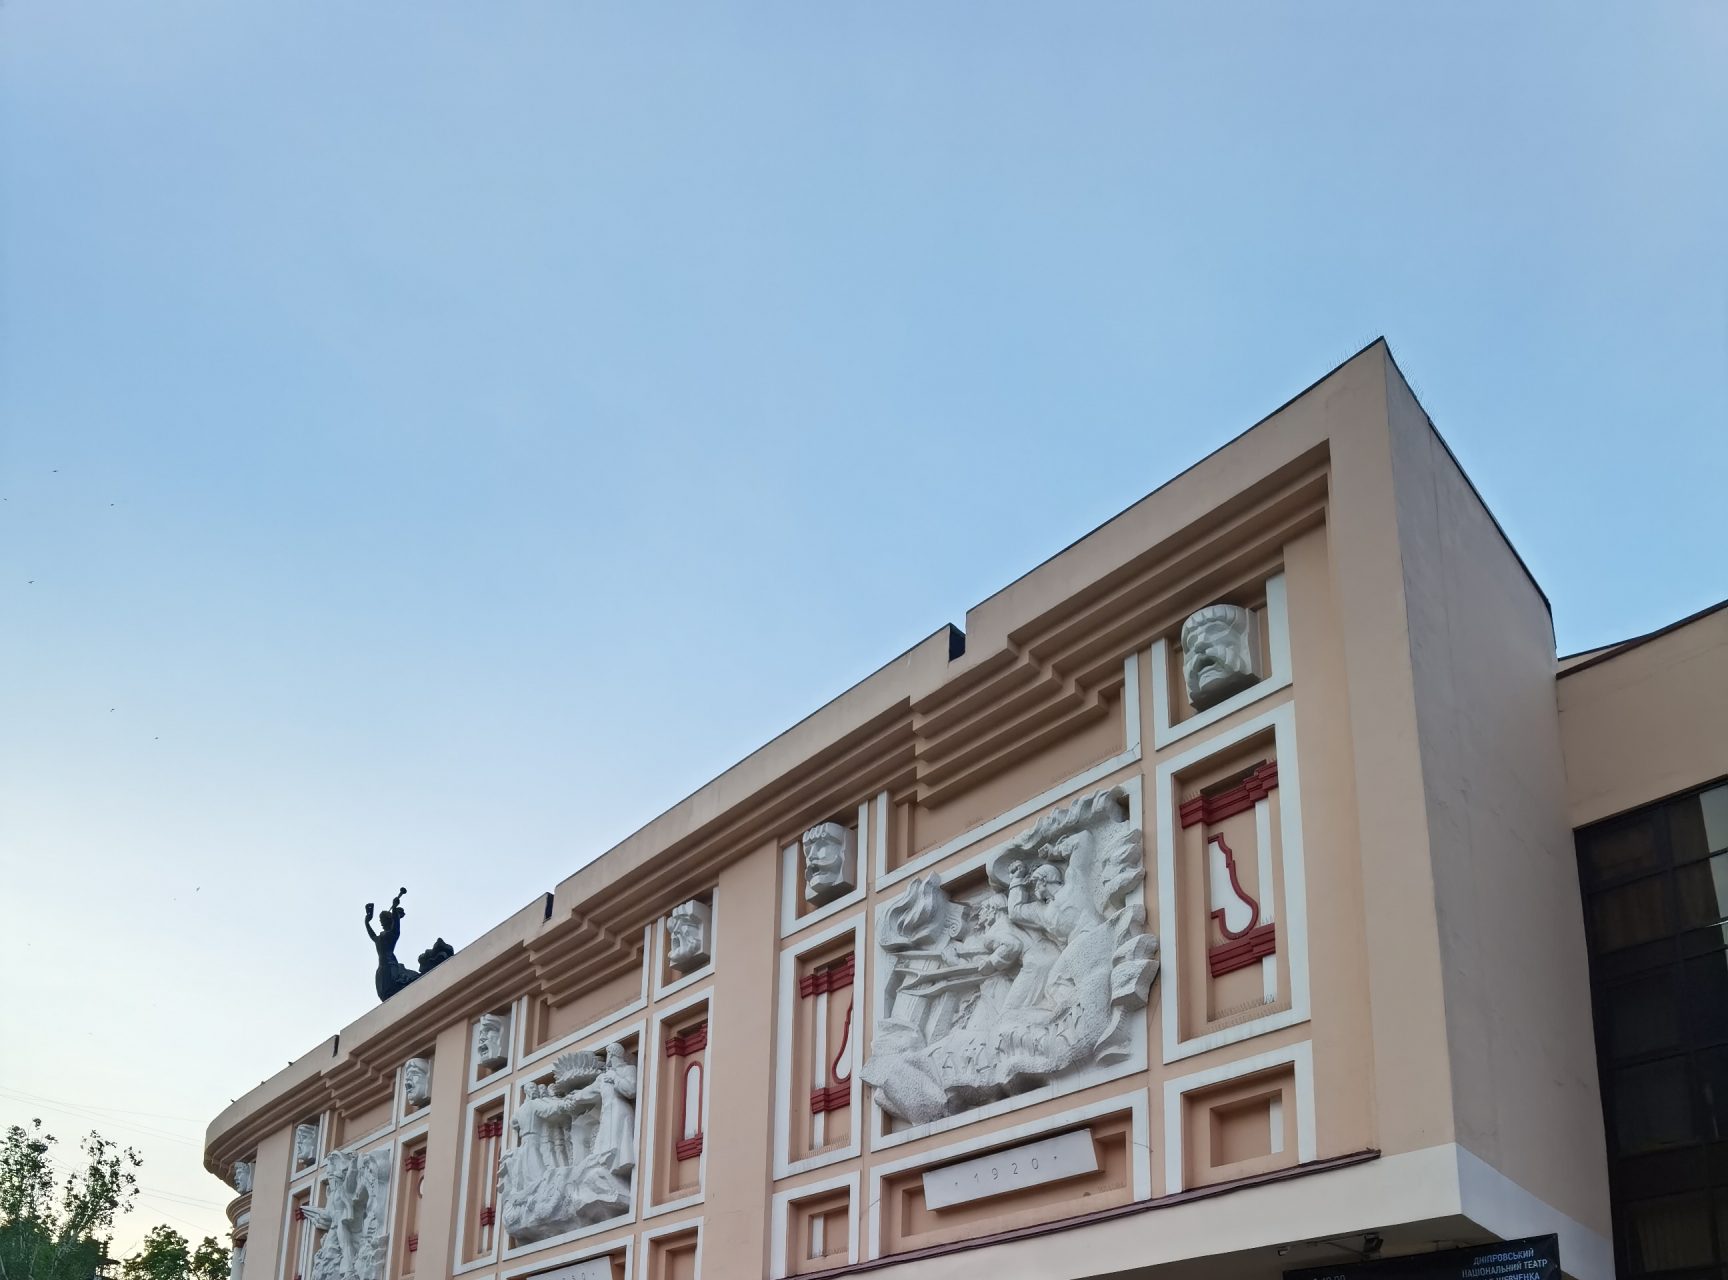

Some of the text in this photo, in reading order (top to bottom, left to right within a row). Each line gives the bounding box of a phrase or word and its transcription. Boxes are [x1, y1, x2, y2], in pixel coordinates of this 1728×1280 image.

[973, 1157, 1039, 1184] 1920
[1473, 1247, 1534, 1266] ДНІПРОВСЬКИЙ
[1462, 1258, 1548, 1278] НАЦІОНАЛЬНИЙ ТЕАТР
